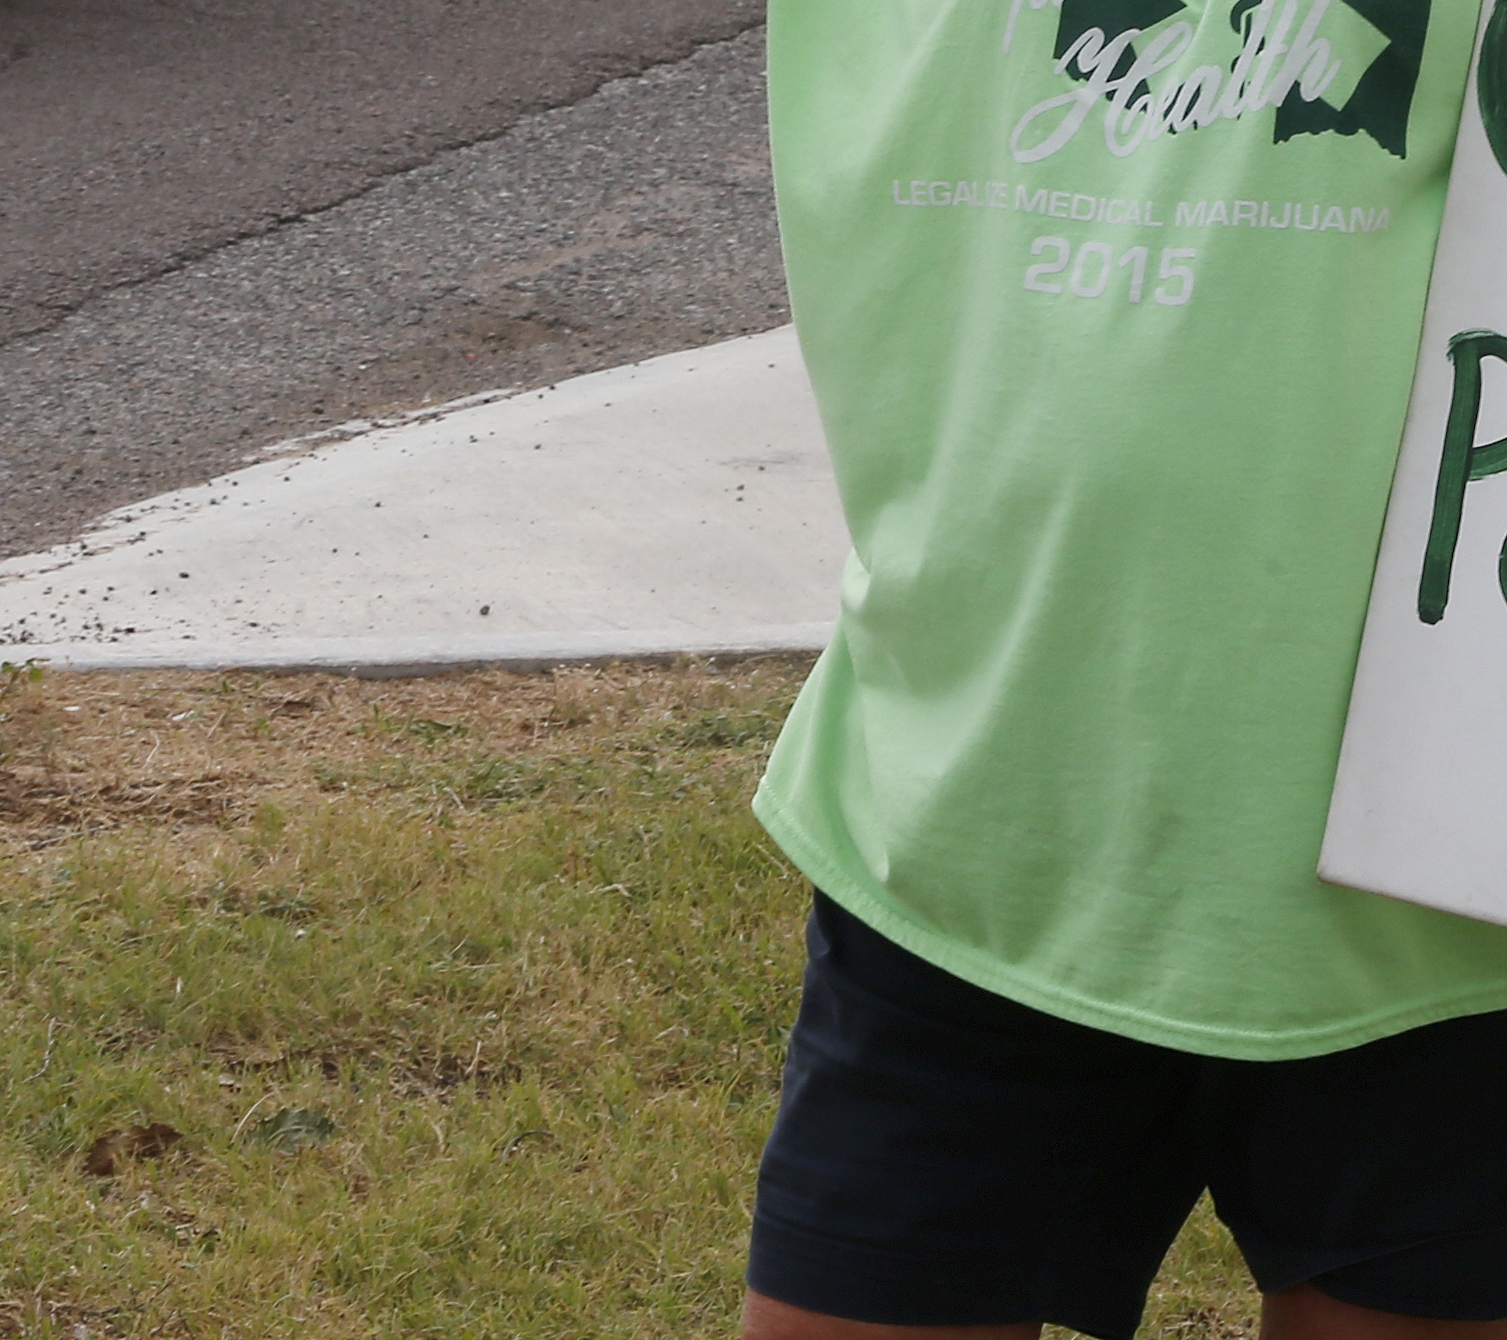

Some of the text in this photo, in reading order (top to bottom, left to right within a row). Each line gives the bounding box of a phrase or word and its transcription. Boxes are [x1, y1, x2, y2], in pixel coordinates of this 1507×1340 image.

[1013, 184, 1165, 229] MEDICAL
[1174, 199, 1390, 235] MARIJUANA
[1023, 235, 1197, 308] 2015
